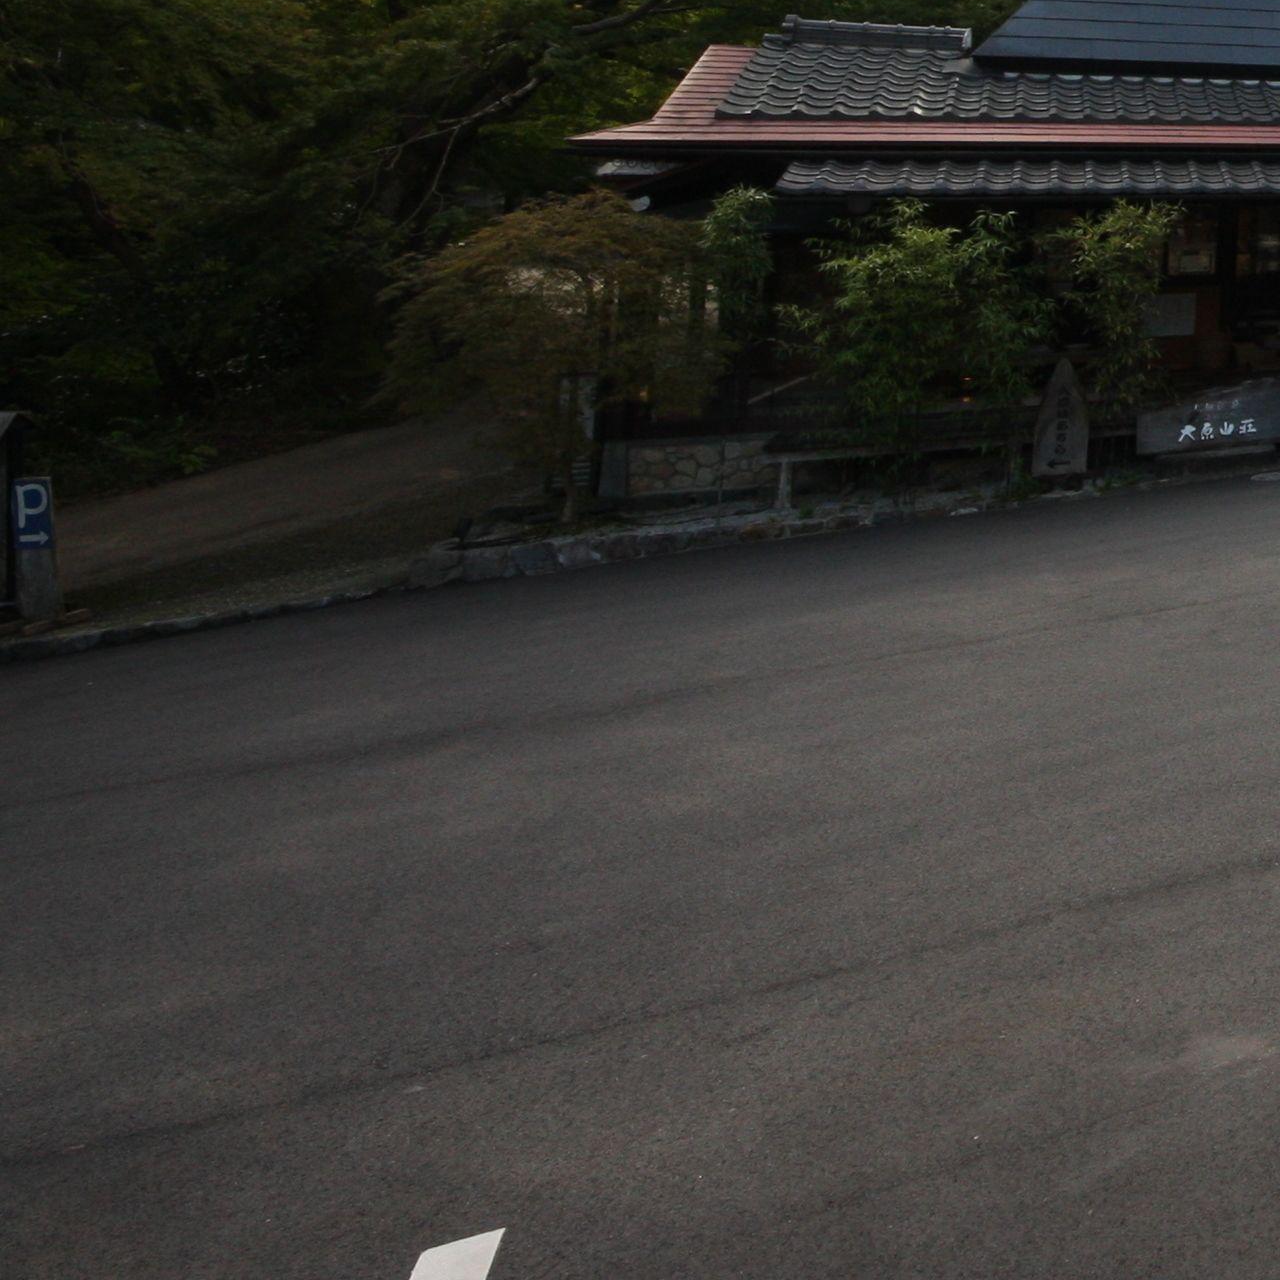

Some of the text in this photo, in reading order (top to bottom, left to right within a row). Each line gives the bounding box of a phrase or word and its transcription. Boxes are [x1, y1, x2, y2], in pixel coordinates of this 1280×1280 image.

[1178, 417, 1257, 442] 大原山荘
[15, 484, 48, 529] P
